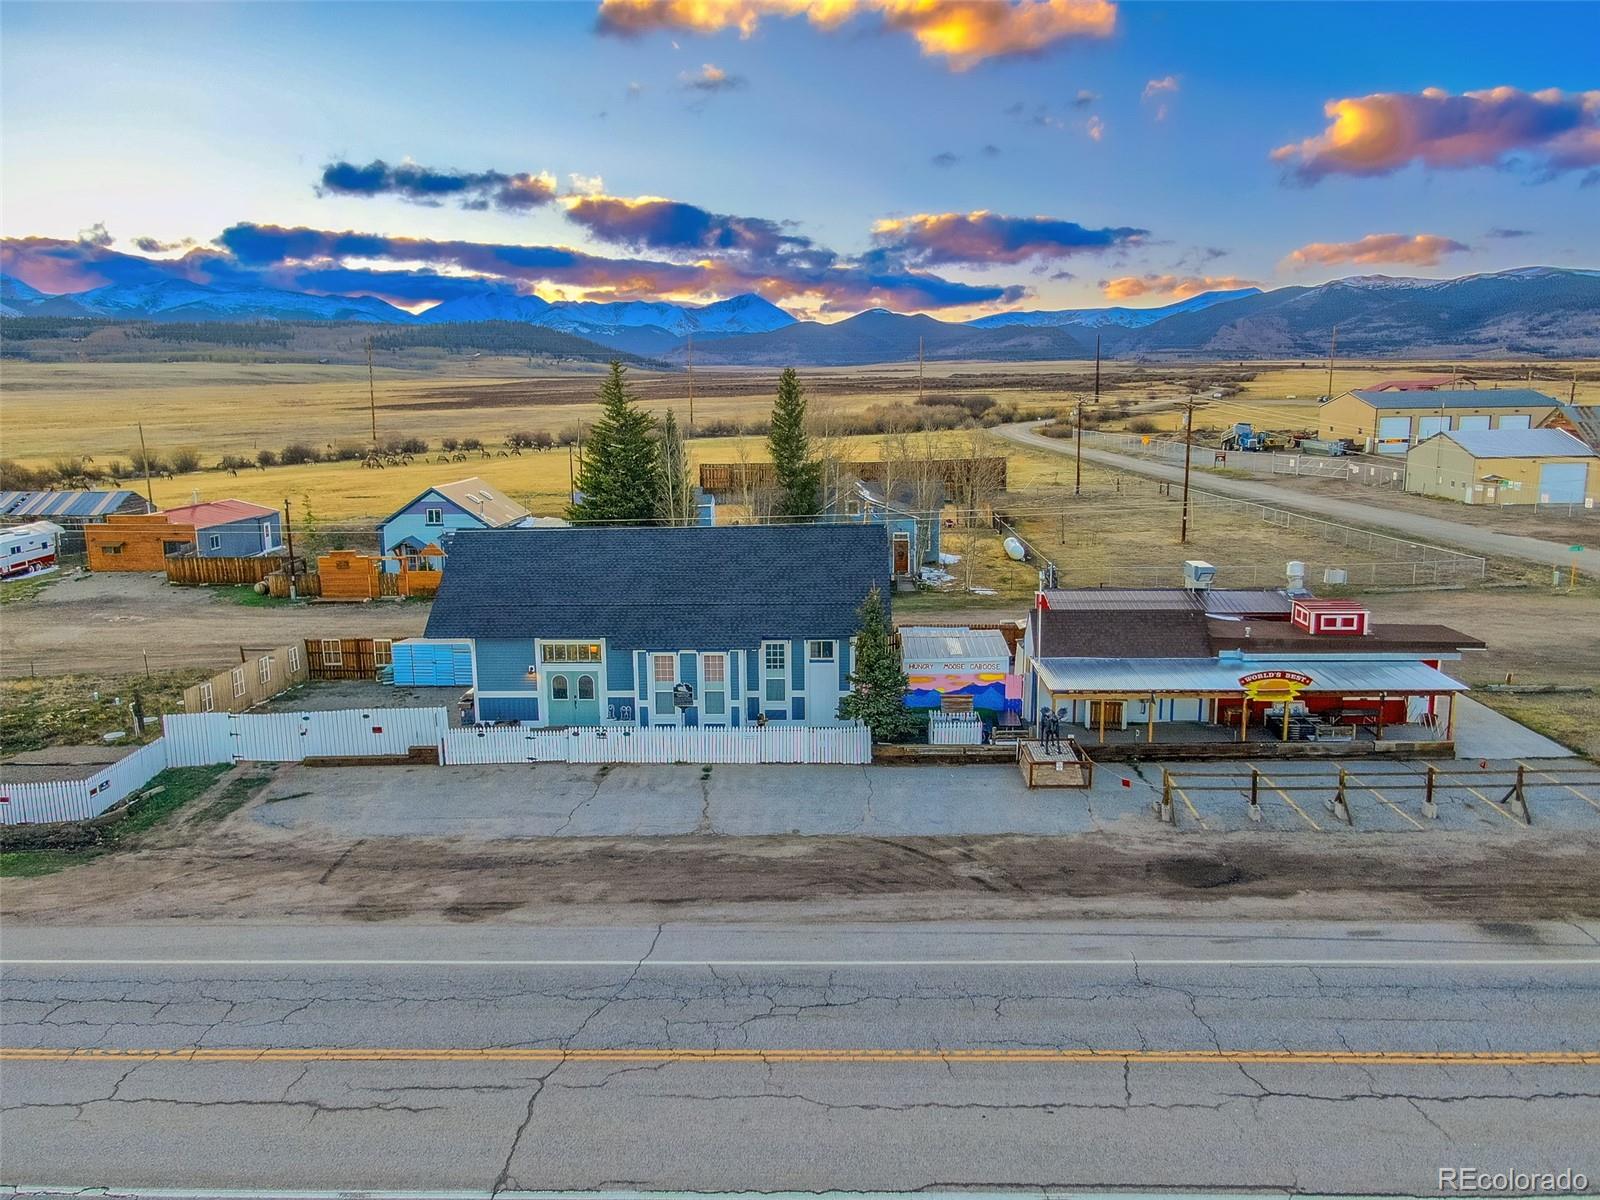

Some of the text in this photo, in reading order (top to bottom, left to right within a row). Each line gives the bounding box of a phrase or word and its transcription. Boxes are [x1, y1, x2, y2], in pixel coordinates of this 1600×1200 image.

[969, 663, 1001, 671] CABOOSE
[1244, 672, 1307, 683] WORLD'S BEST
